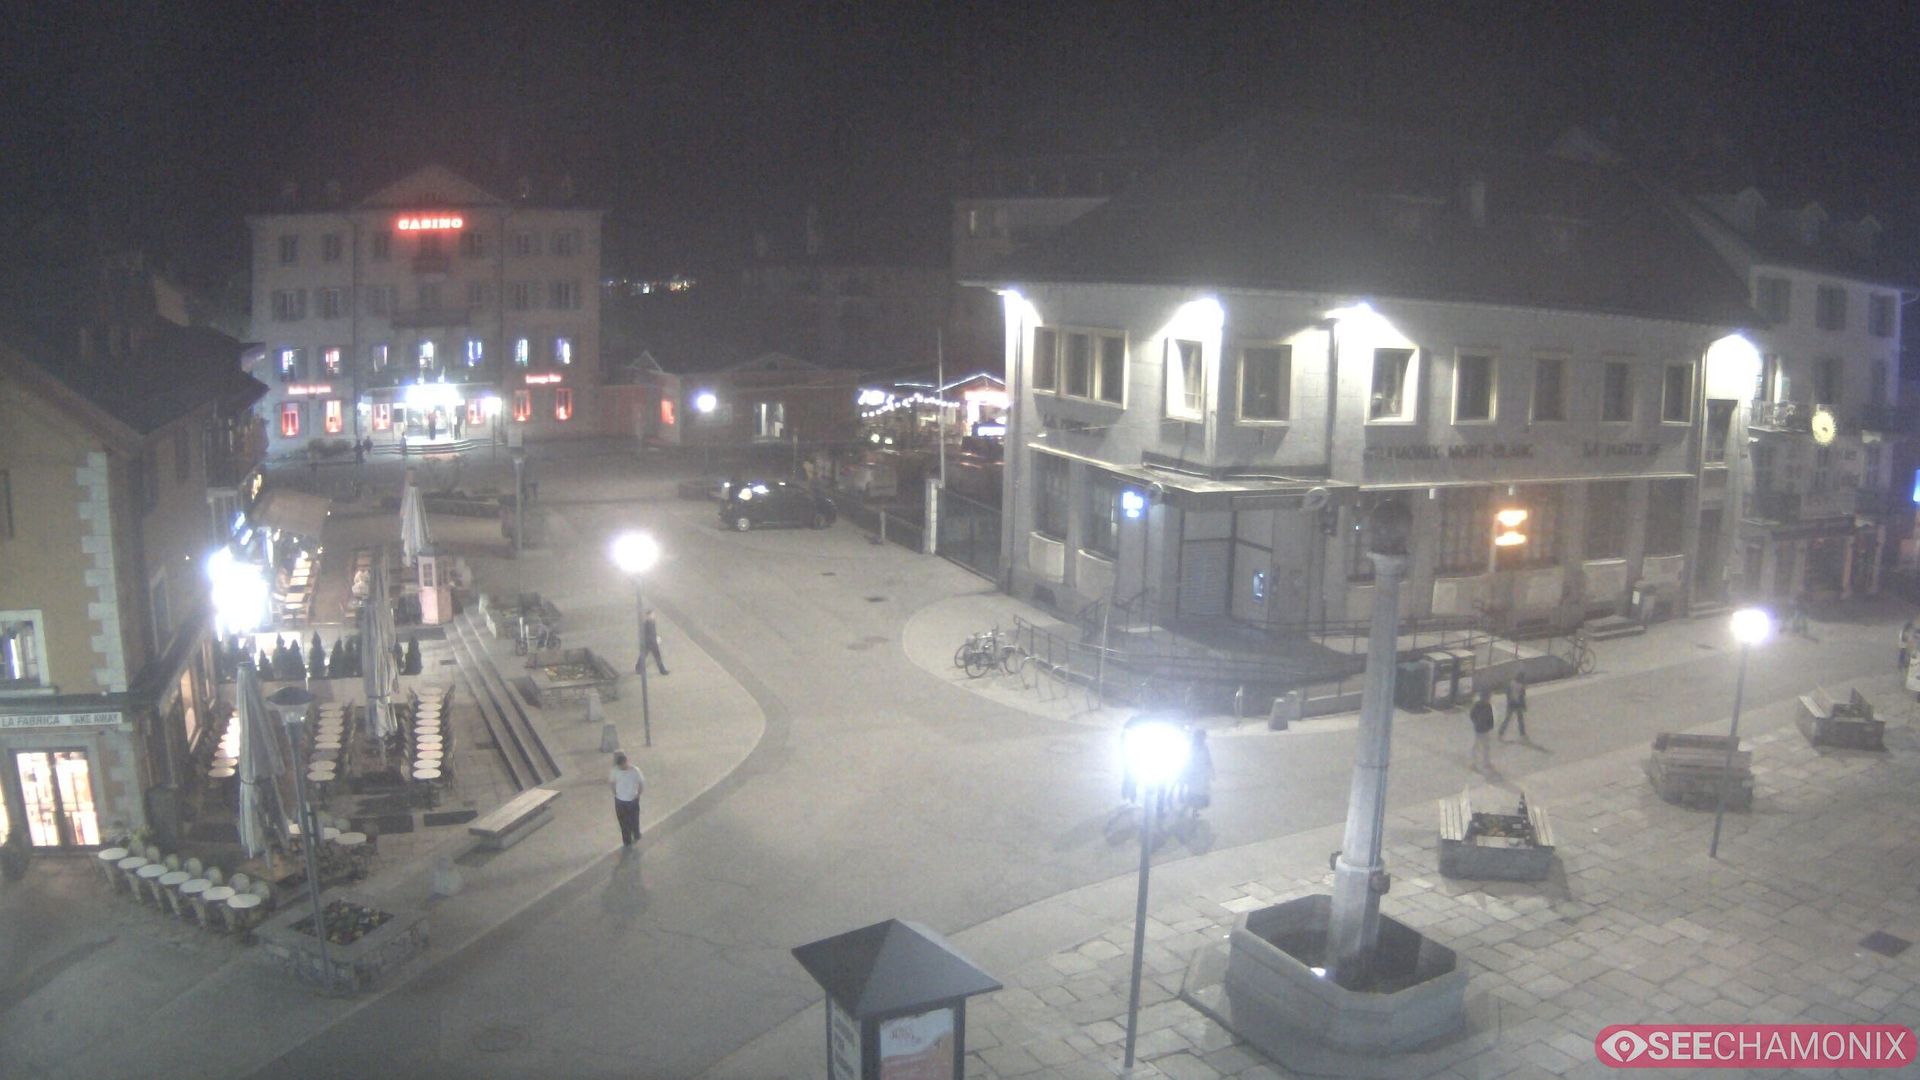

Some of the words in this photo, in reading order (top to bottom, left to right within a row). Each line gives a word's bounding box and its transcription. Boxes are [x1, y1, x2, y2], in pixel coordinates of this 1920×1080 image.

[398, 217, 463, 230] CASINO
[1, 716, 15, 728] LA
[17, 715, 60, 727] FABRICA
[69, 714, 92, 724] TAKE
[94, 713, 119, 723] AWAY
